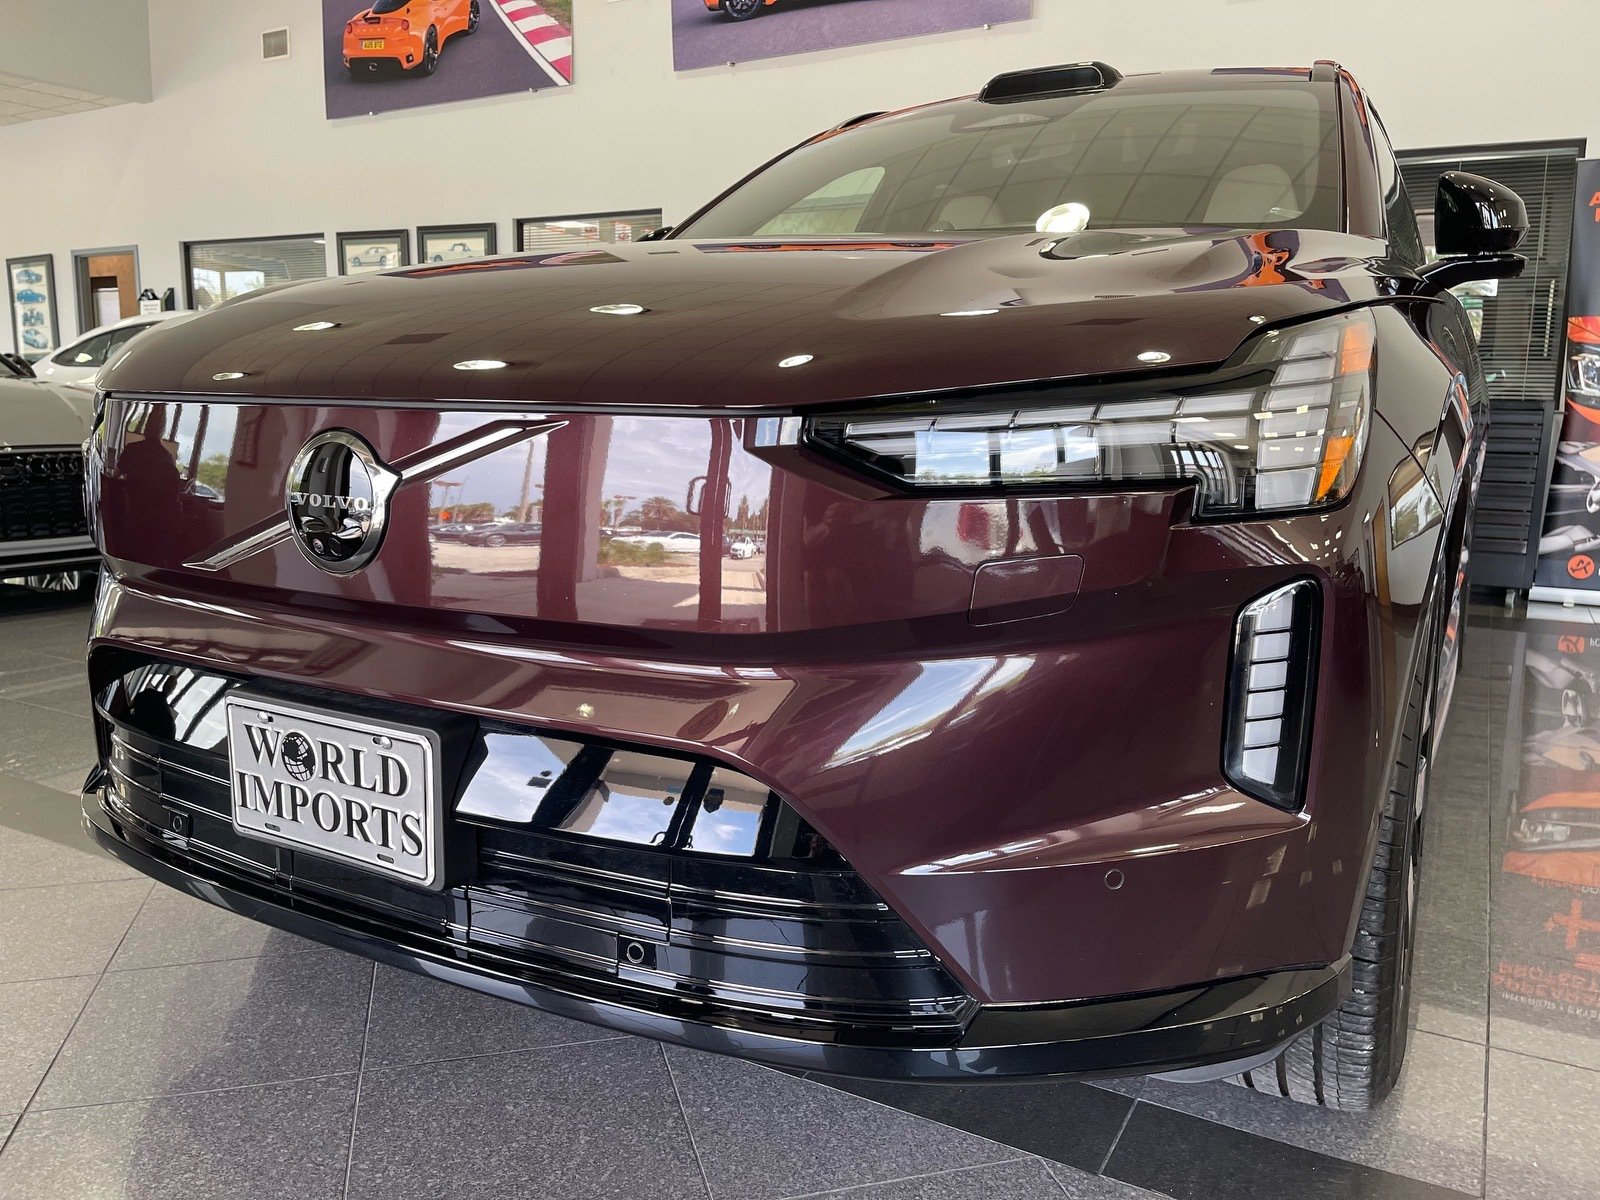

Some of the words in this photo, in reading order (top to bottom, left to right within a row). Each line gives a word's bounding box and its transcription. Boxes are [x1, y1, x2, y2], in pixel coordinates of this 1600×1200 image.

[293, 492, 368, 511] VOLVO
[243, 722, 411, 797] WORLD
[235, 771, 423, 857] IMPORTS
